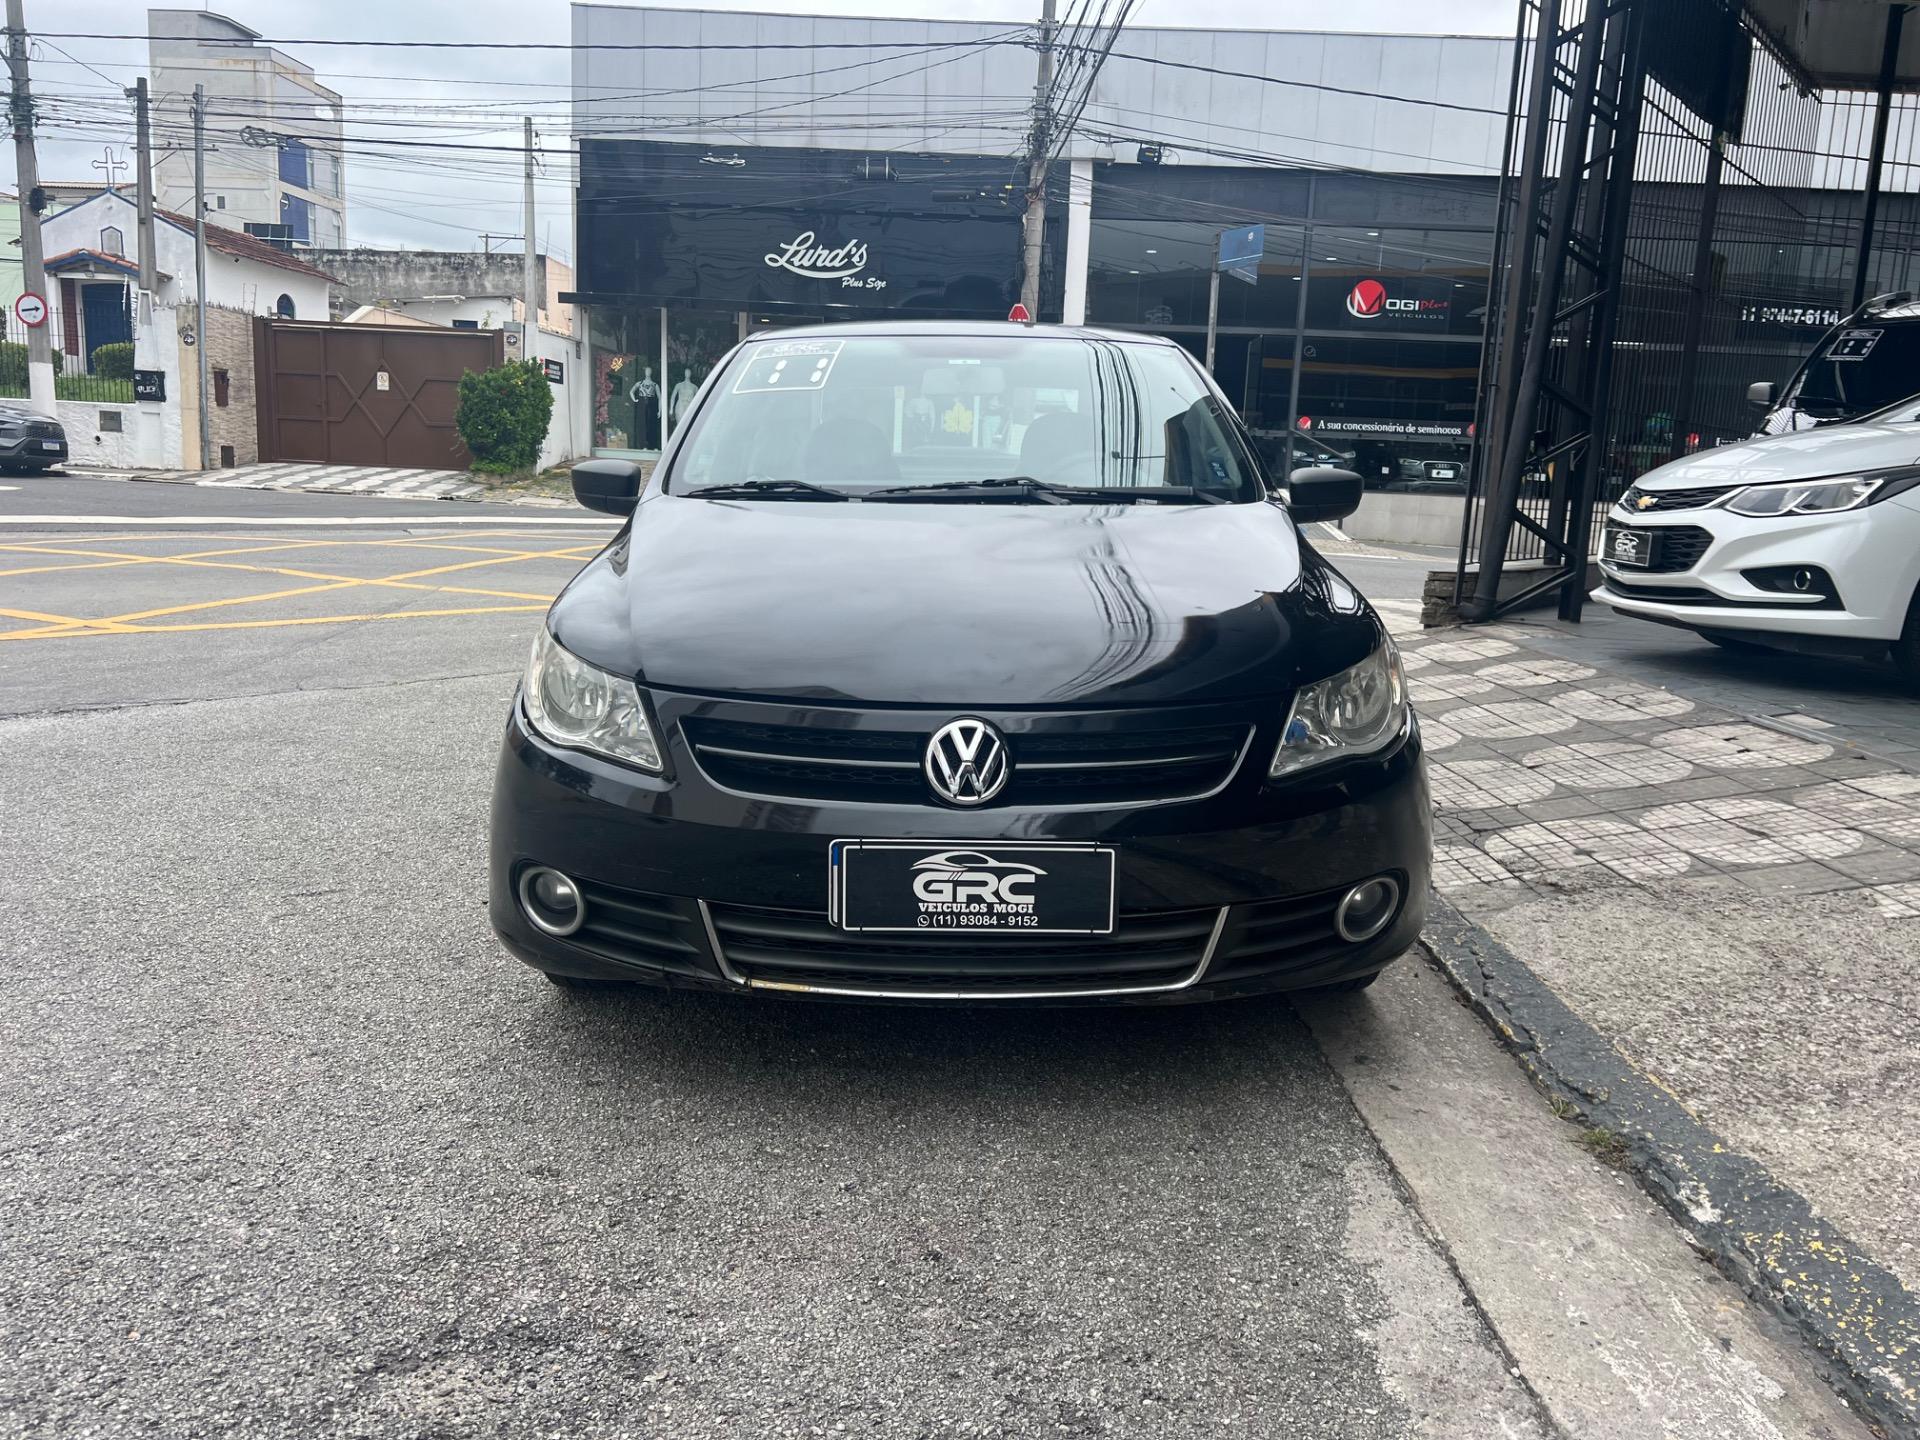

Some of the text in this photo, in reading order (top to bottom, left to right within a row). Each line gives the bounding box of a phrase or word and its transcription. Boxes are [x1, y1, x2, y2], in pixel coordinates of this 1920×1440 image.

[764, 231, 868, 279] Lurd's
[841, 277, 887, 291] Plus Size
[1348, 281, 1420, 318] MOGI
[1388, 312, 1445, 320] VEICULOS
[1317, 419, 1325, 430] A
[1326, 422, 1341, 430] sua
[1342, 422, 1404, 433] concessionária
[1405, 423, 1416, 434] de
[912, 871, 1036, 904] GRC
[918, 903, 1034, 914] VEICULOS MOGI
[932, 914, 957, 928] (11)
[959, 915, 998, 926] 93084
[1007, 915, 1039, 926] 9152
